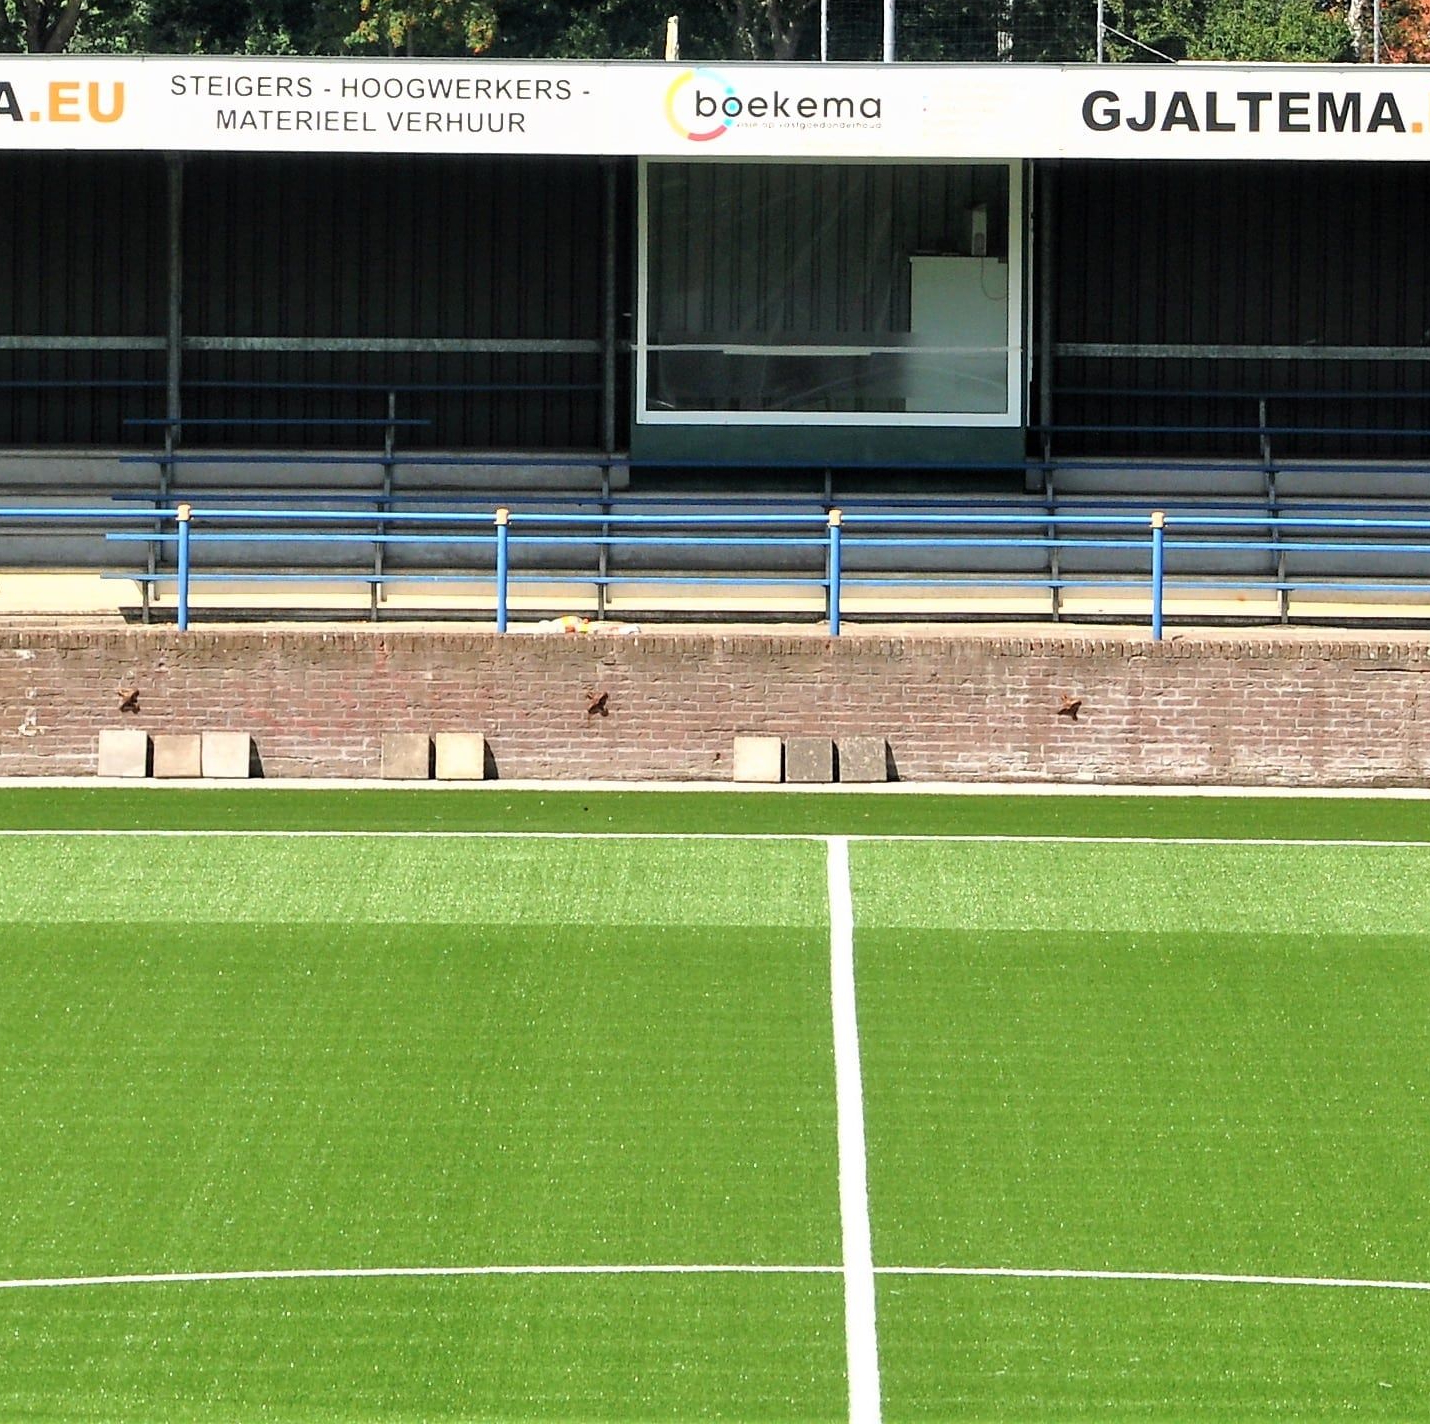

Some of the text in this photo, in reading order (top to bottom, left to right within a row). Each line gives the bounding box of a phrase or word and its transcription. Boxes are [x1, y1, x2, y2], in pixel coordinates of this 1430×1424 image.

[170, 74, 313, 98] STEIGERS
[341, 77, 572, 101] HOOGWERKERS
[695, 90, 881, 119] boekema
[216, 109, 526, 133] MATERIEEL VERHUUR
